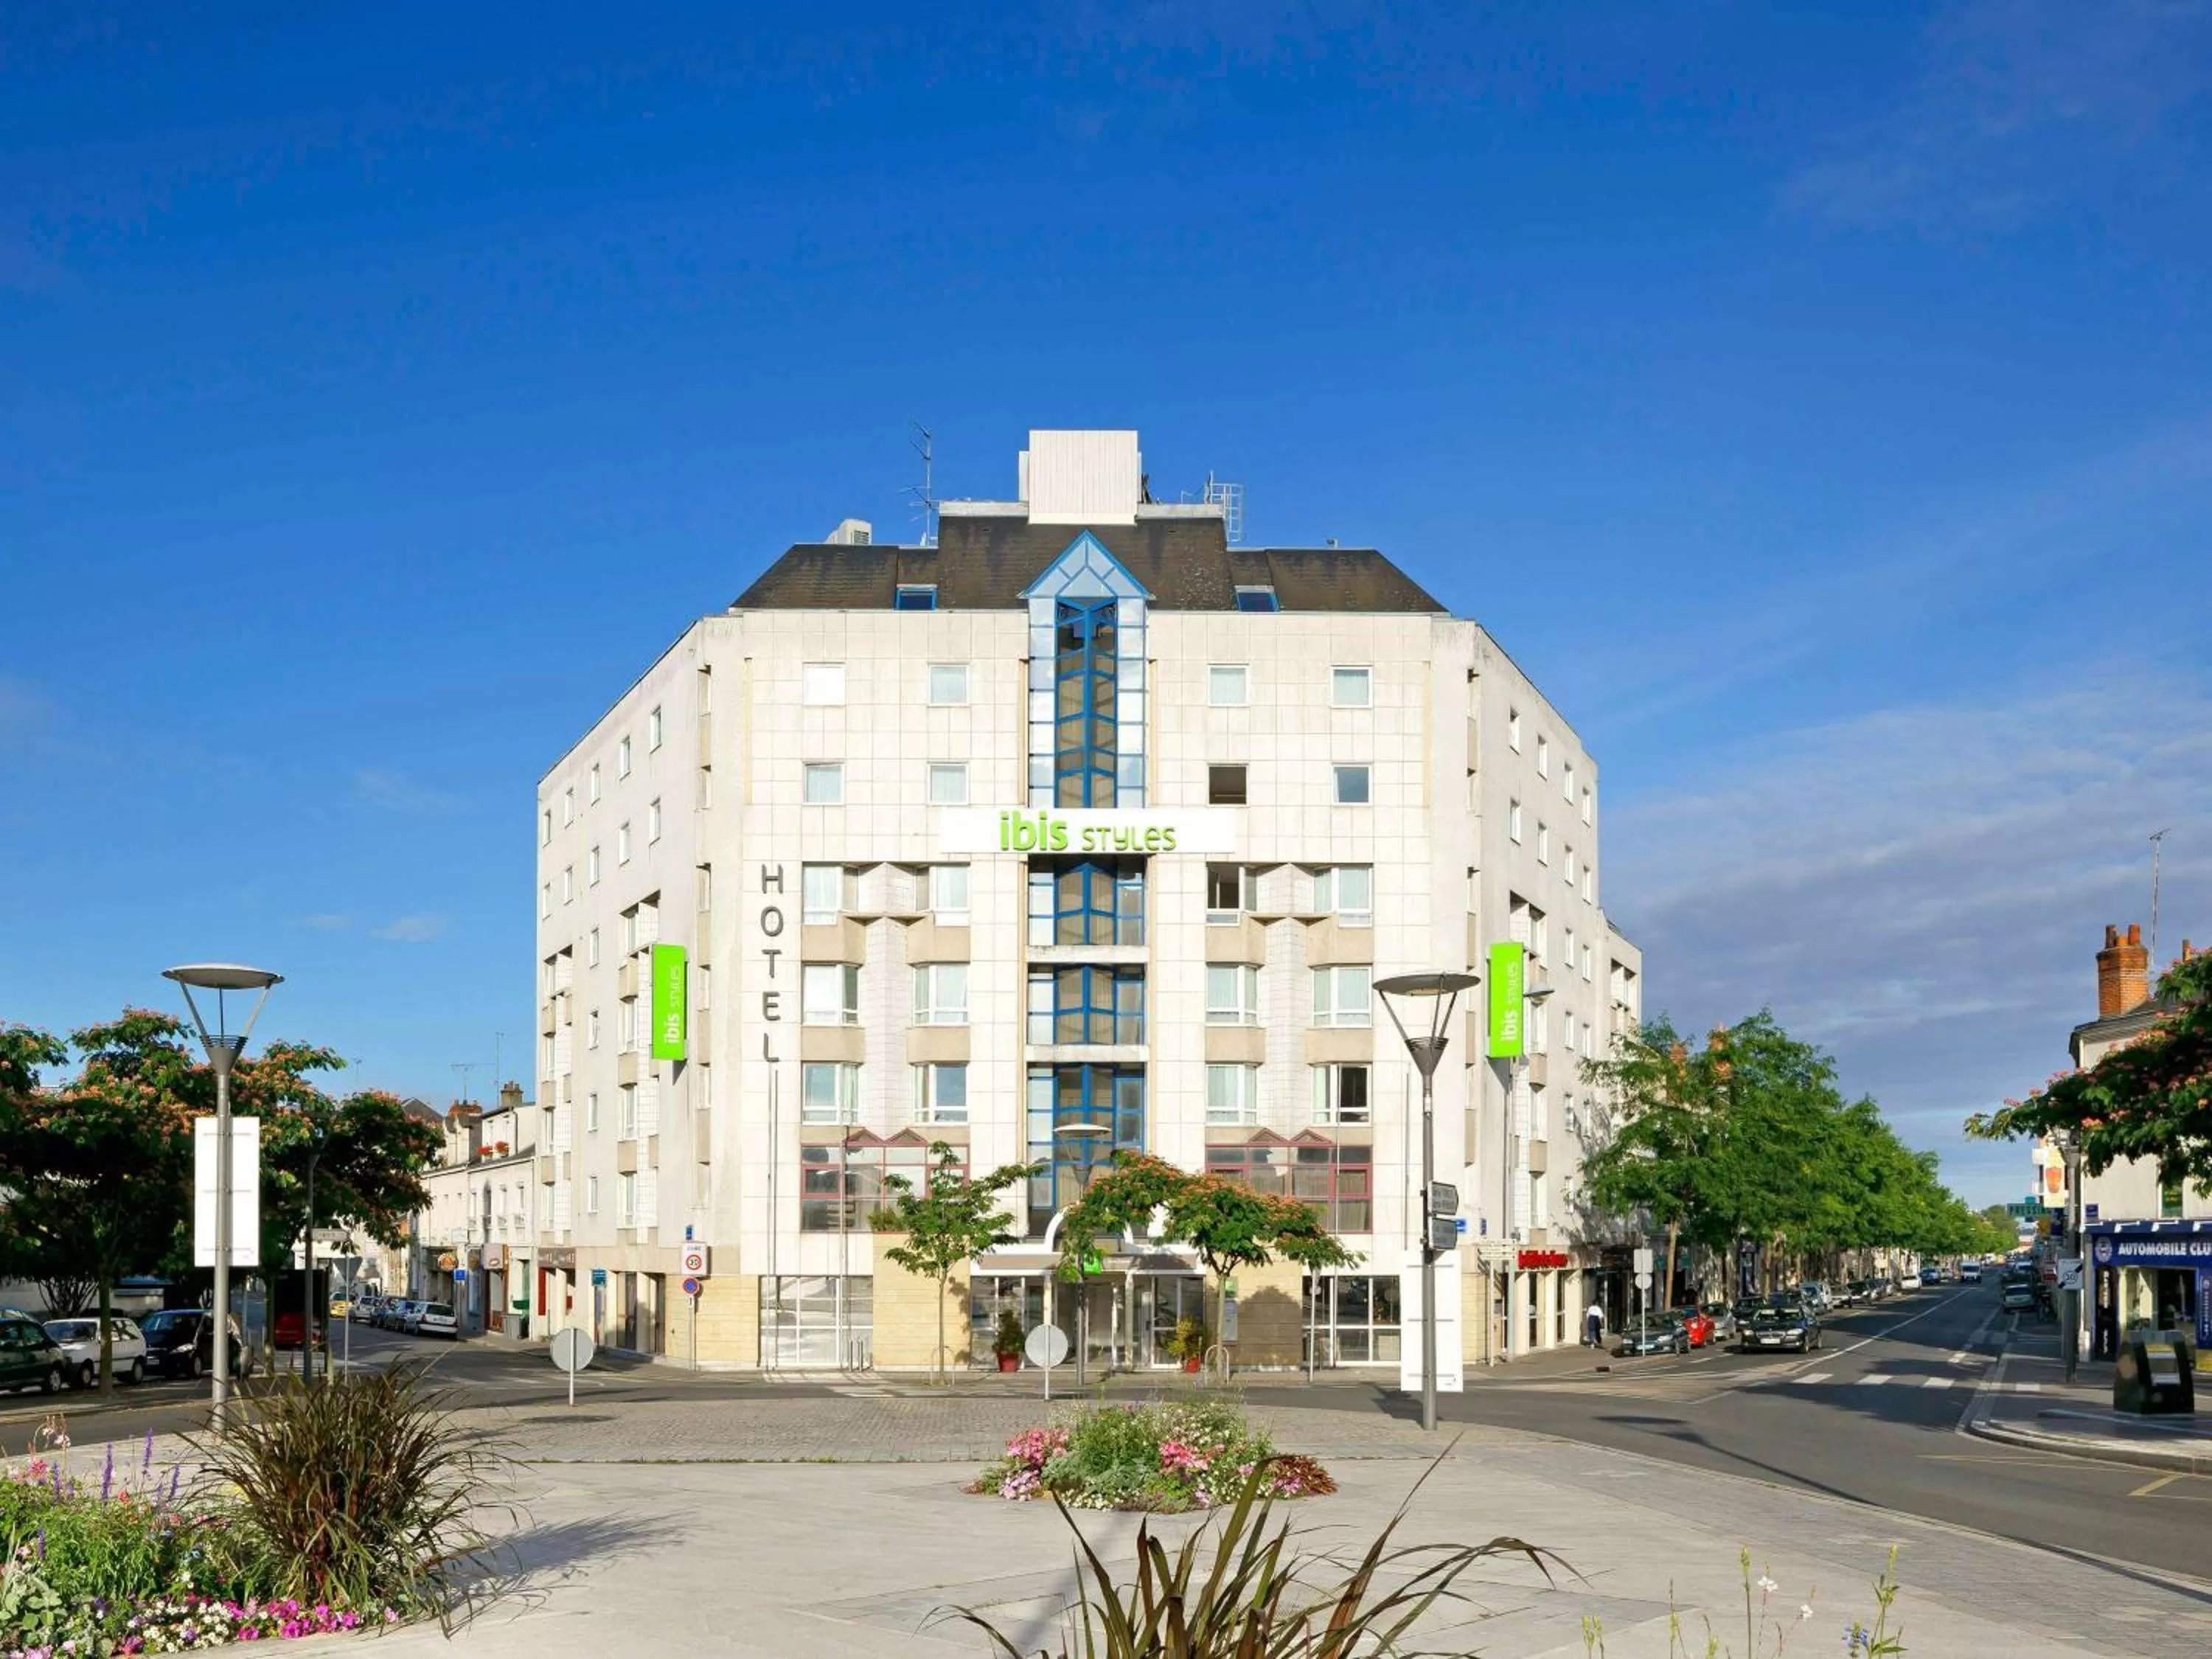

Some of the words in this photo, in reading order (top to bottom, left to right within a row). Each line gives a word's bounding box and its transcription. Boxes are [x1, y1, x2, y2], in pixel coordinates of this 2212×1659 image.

[1000, 810, 1068, 851] ibis
[760, 863, 783, 1062] HOTEL
[664, 1014, 680, 1044] ibis
[2118, 1242, 2187, 1256] AUTOMOBILE
